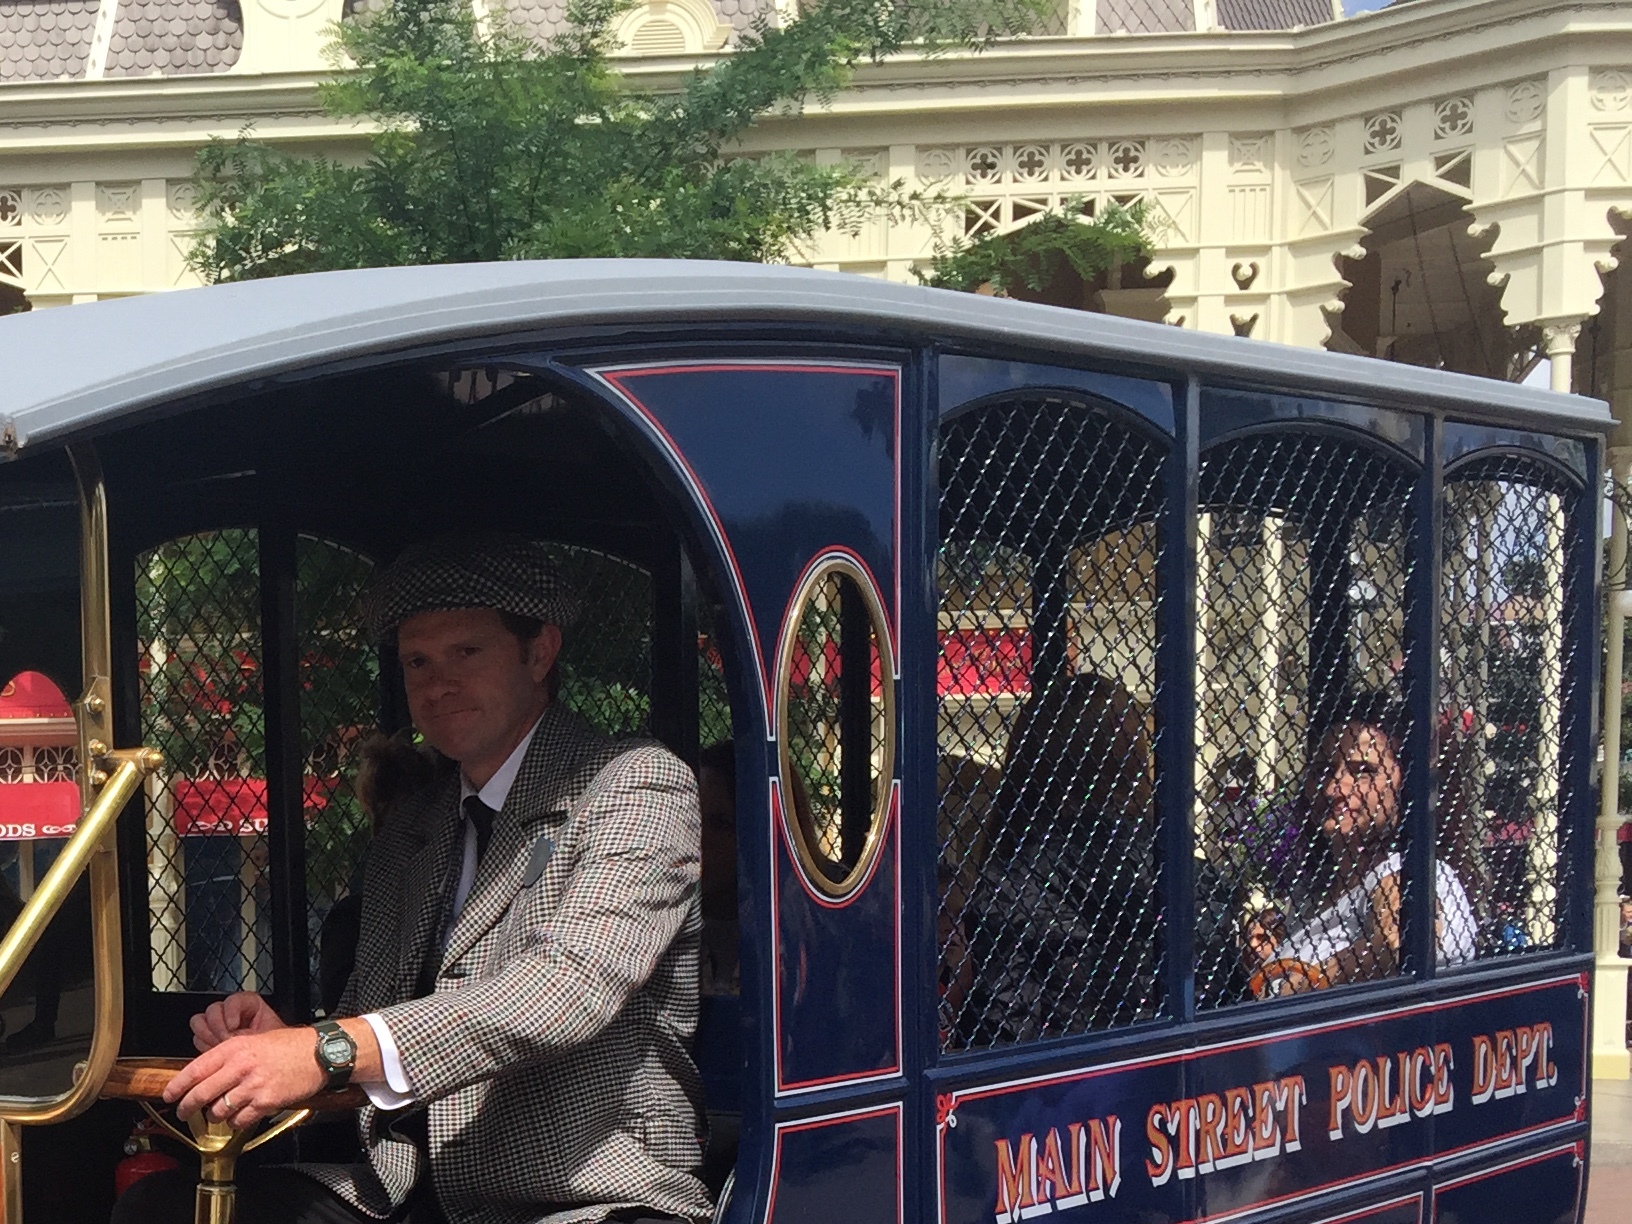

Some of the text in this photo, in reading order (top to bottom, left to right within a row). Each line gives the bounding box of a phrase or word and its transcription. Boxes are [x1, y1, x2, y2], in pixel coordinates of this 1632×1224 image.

[1145, 1075, 1306, 1188] STREET
[1328, 1042, 1456, 1141] POLICE
[1471, 1021, 1558, 1106] DEPT.
